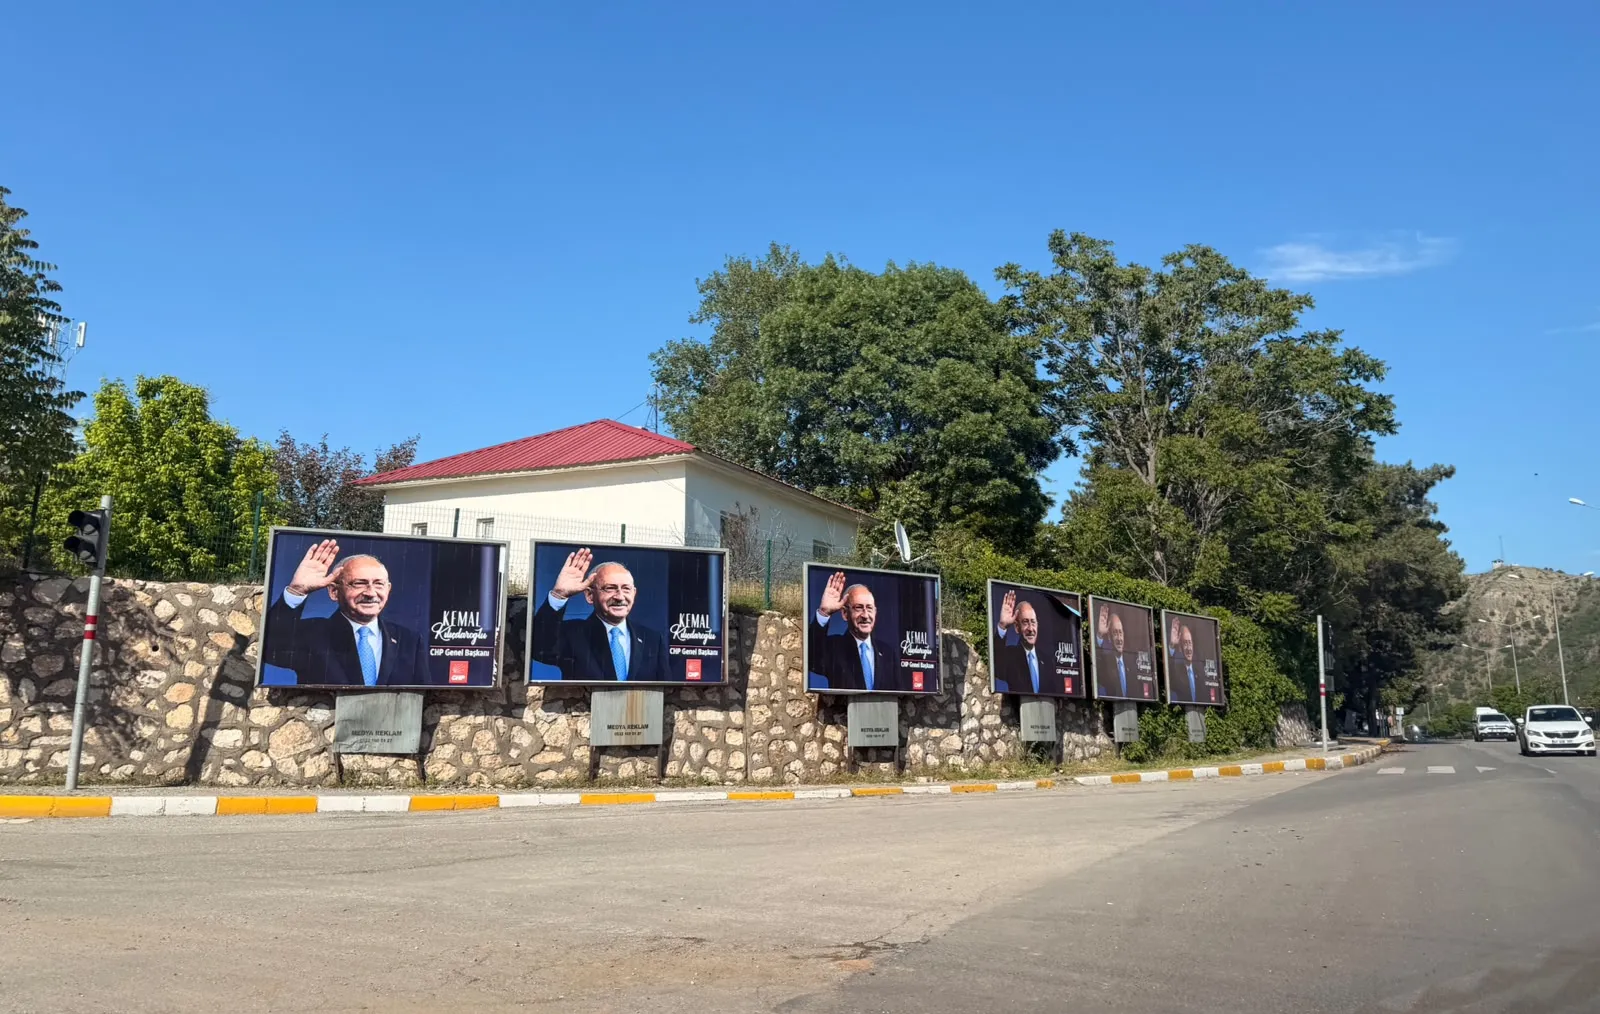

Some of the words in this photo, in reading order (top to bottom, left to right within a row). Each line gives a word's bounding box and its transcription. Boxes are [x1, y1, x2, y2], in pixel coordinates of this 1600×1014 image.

[443, 610, 481, 627] KEMAL
[679, 612, 710, 629] KEMAL
[906, 630, 928, 645] KEMAL
[430, 648, 444, 656] CHP
[445, 648, 464, 656] Genel
[465, 649, 490, 658] Başkanı
[669, 647, 681, 655] CHP
[682, 647, 697, 656] Genel
